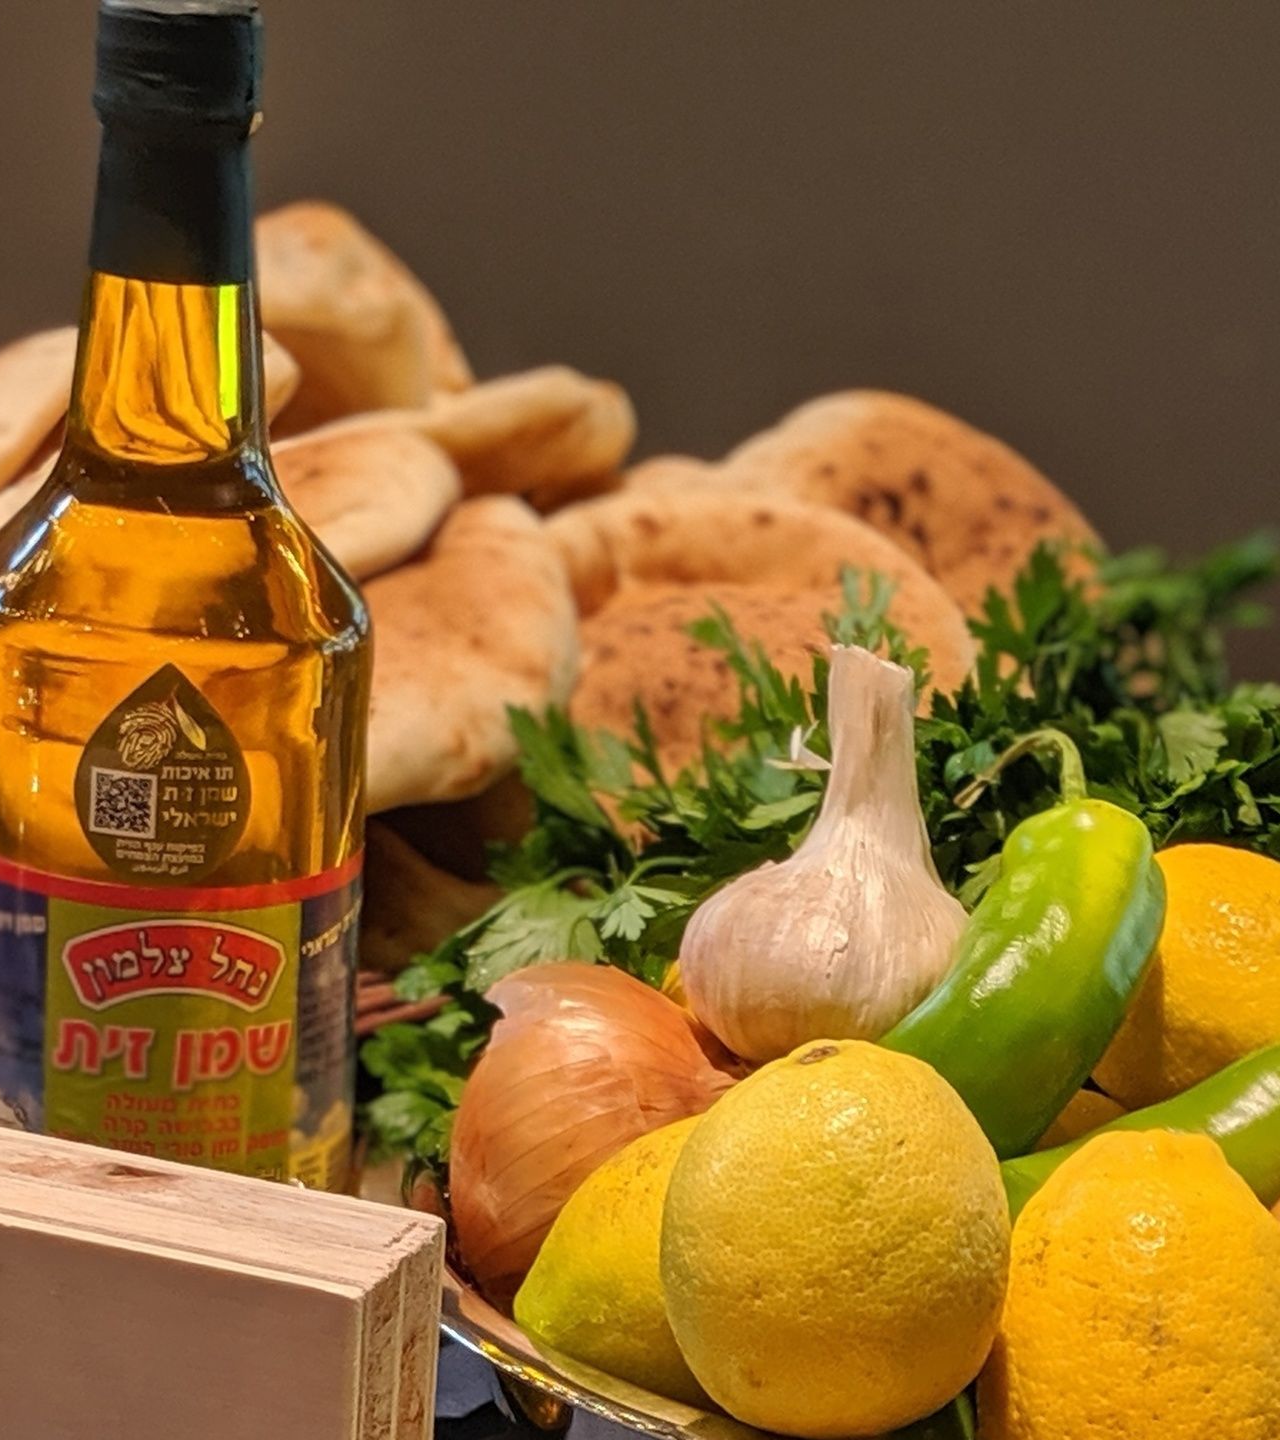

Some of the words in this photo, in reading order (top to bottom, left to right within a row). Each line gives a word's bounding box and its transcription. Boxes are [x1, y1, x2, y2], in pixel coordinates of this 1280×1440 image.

[160, 766, 211, 781] איכות
[215, 766, 234, 781] תו
[199, 786, 238, 806] שמן
[161, 807, 239, 828] ישראלי
[82, 931, 192, 998] צלמון
[209, 935, 268, 997] נחל
[52, 1018, 155, 1079] זית
[173, 1019, 292, 1091] שמן
